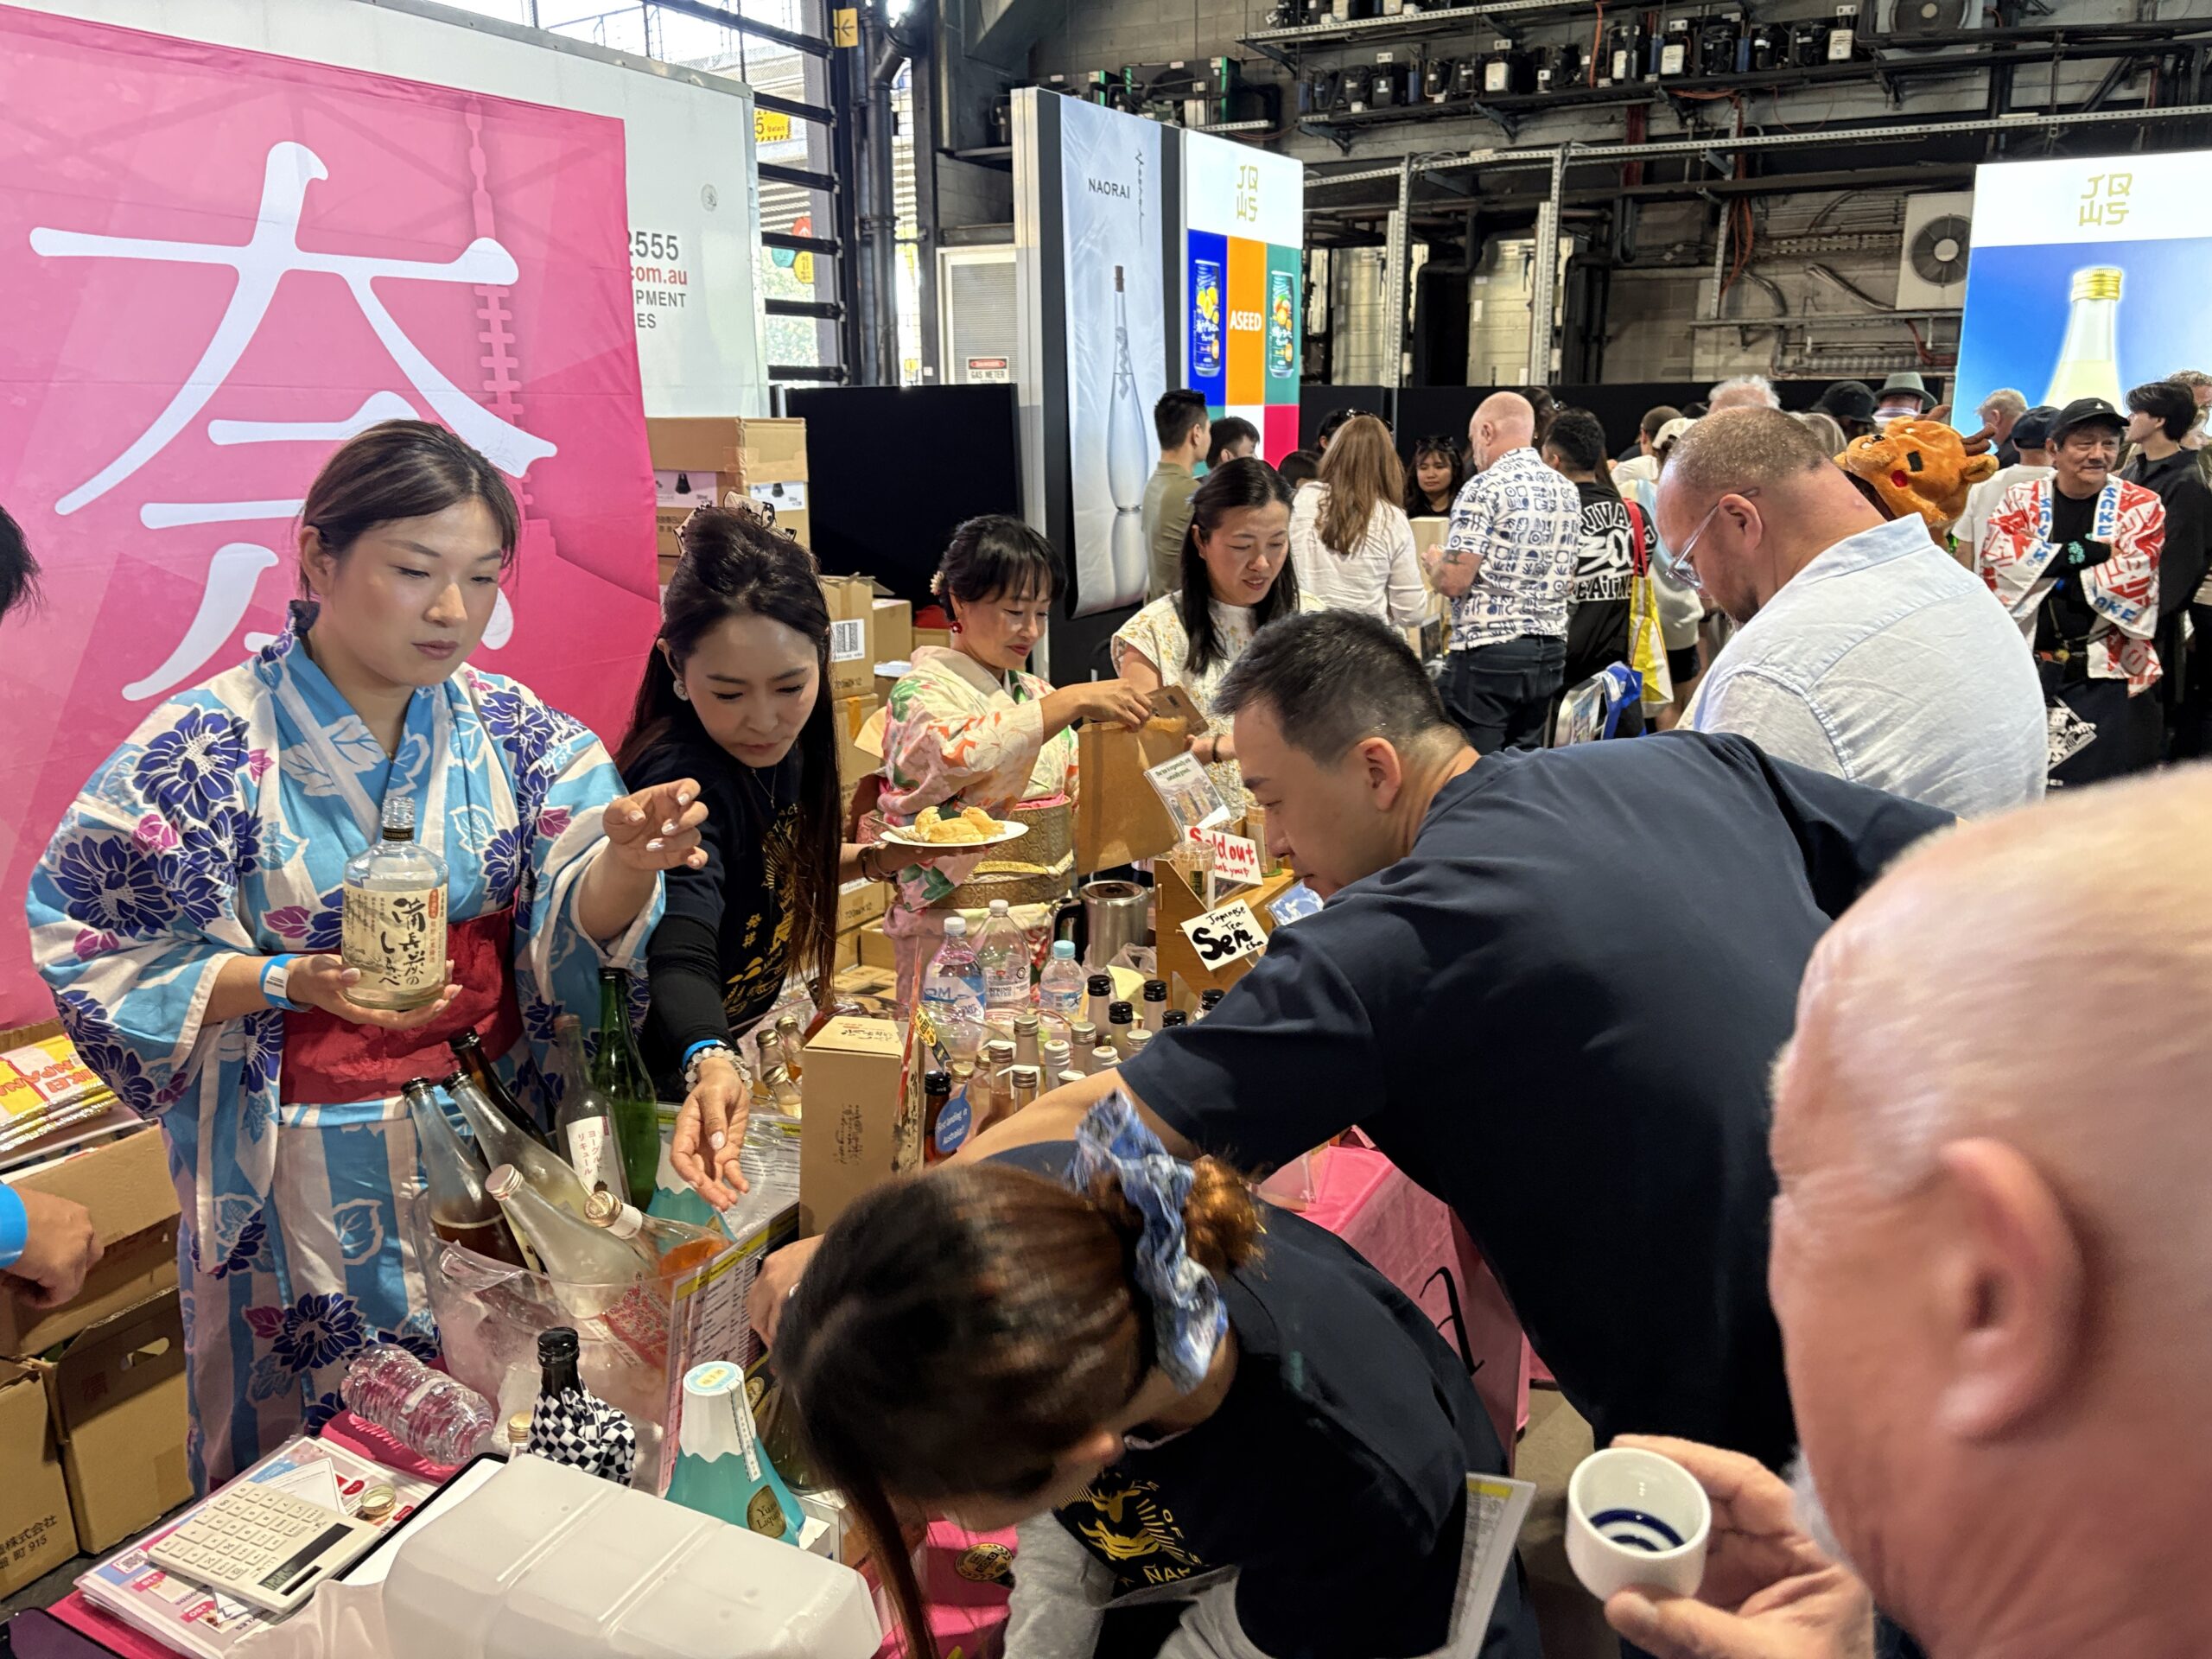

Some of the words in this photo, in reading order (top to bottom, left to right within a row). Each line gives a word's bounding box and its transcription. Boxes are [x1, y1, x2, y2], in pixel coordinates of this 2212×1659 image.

[1089, 177, 1130, 199] NAORAI
[635, 289, 686, 308] PMENT
[636, 313, 657, 329] ES
[1230, 310, 1262, 332] ASEED
[1229, 842, 1255, 866] out
[1230, 867, 1243, 877] you
[1205, 906, 1246, 925] Japanese
[1221, 921, 1243, 931] Tea
[1192, 926, 1253, 960] Sen
[578, 1133, 592, 1175] リキュール
[588, 1130, 603, 1173] ヨーグルト
[28, 1534, 48, 1552] 915
